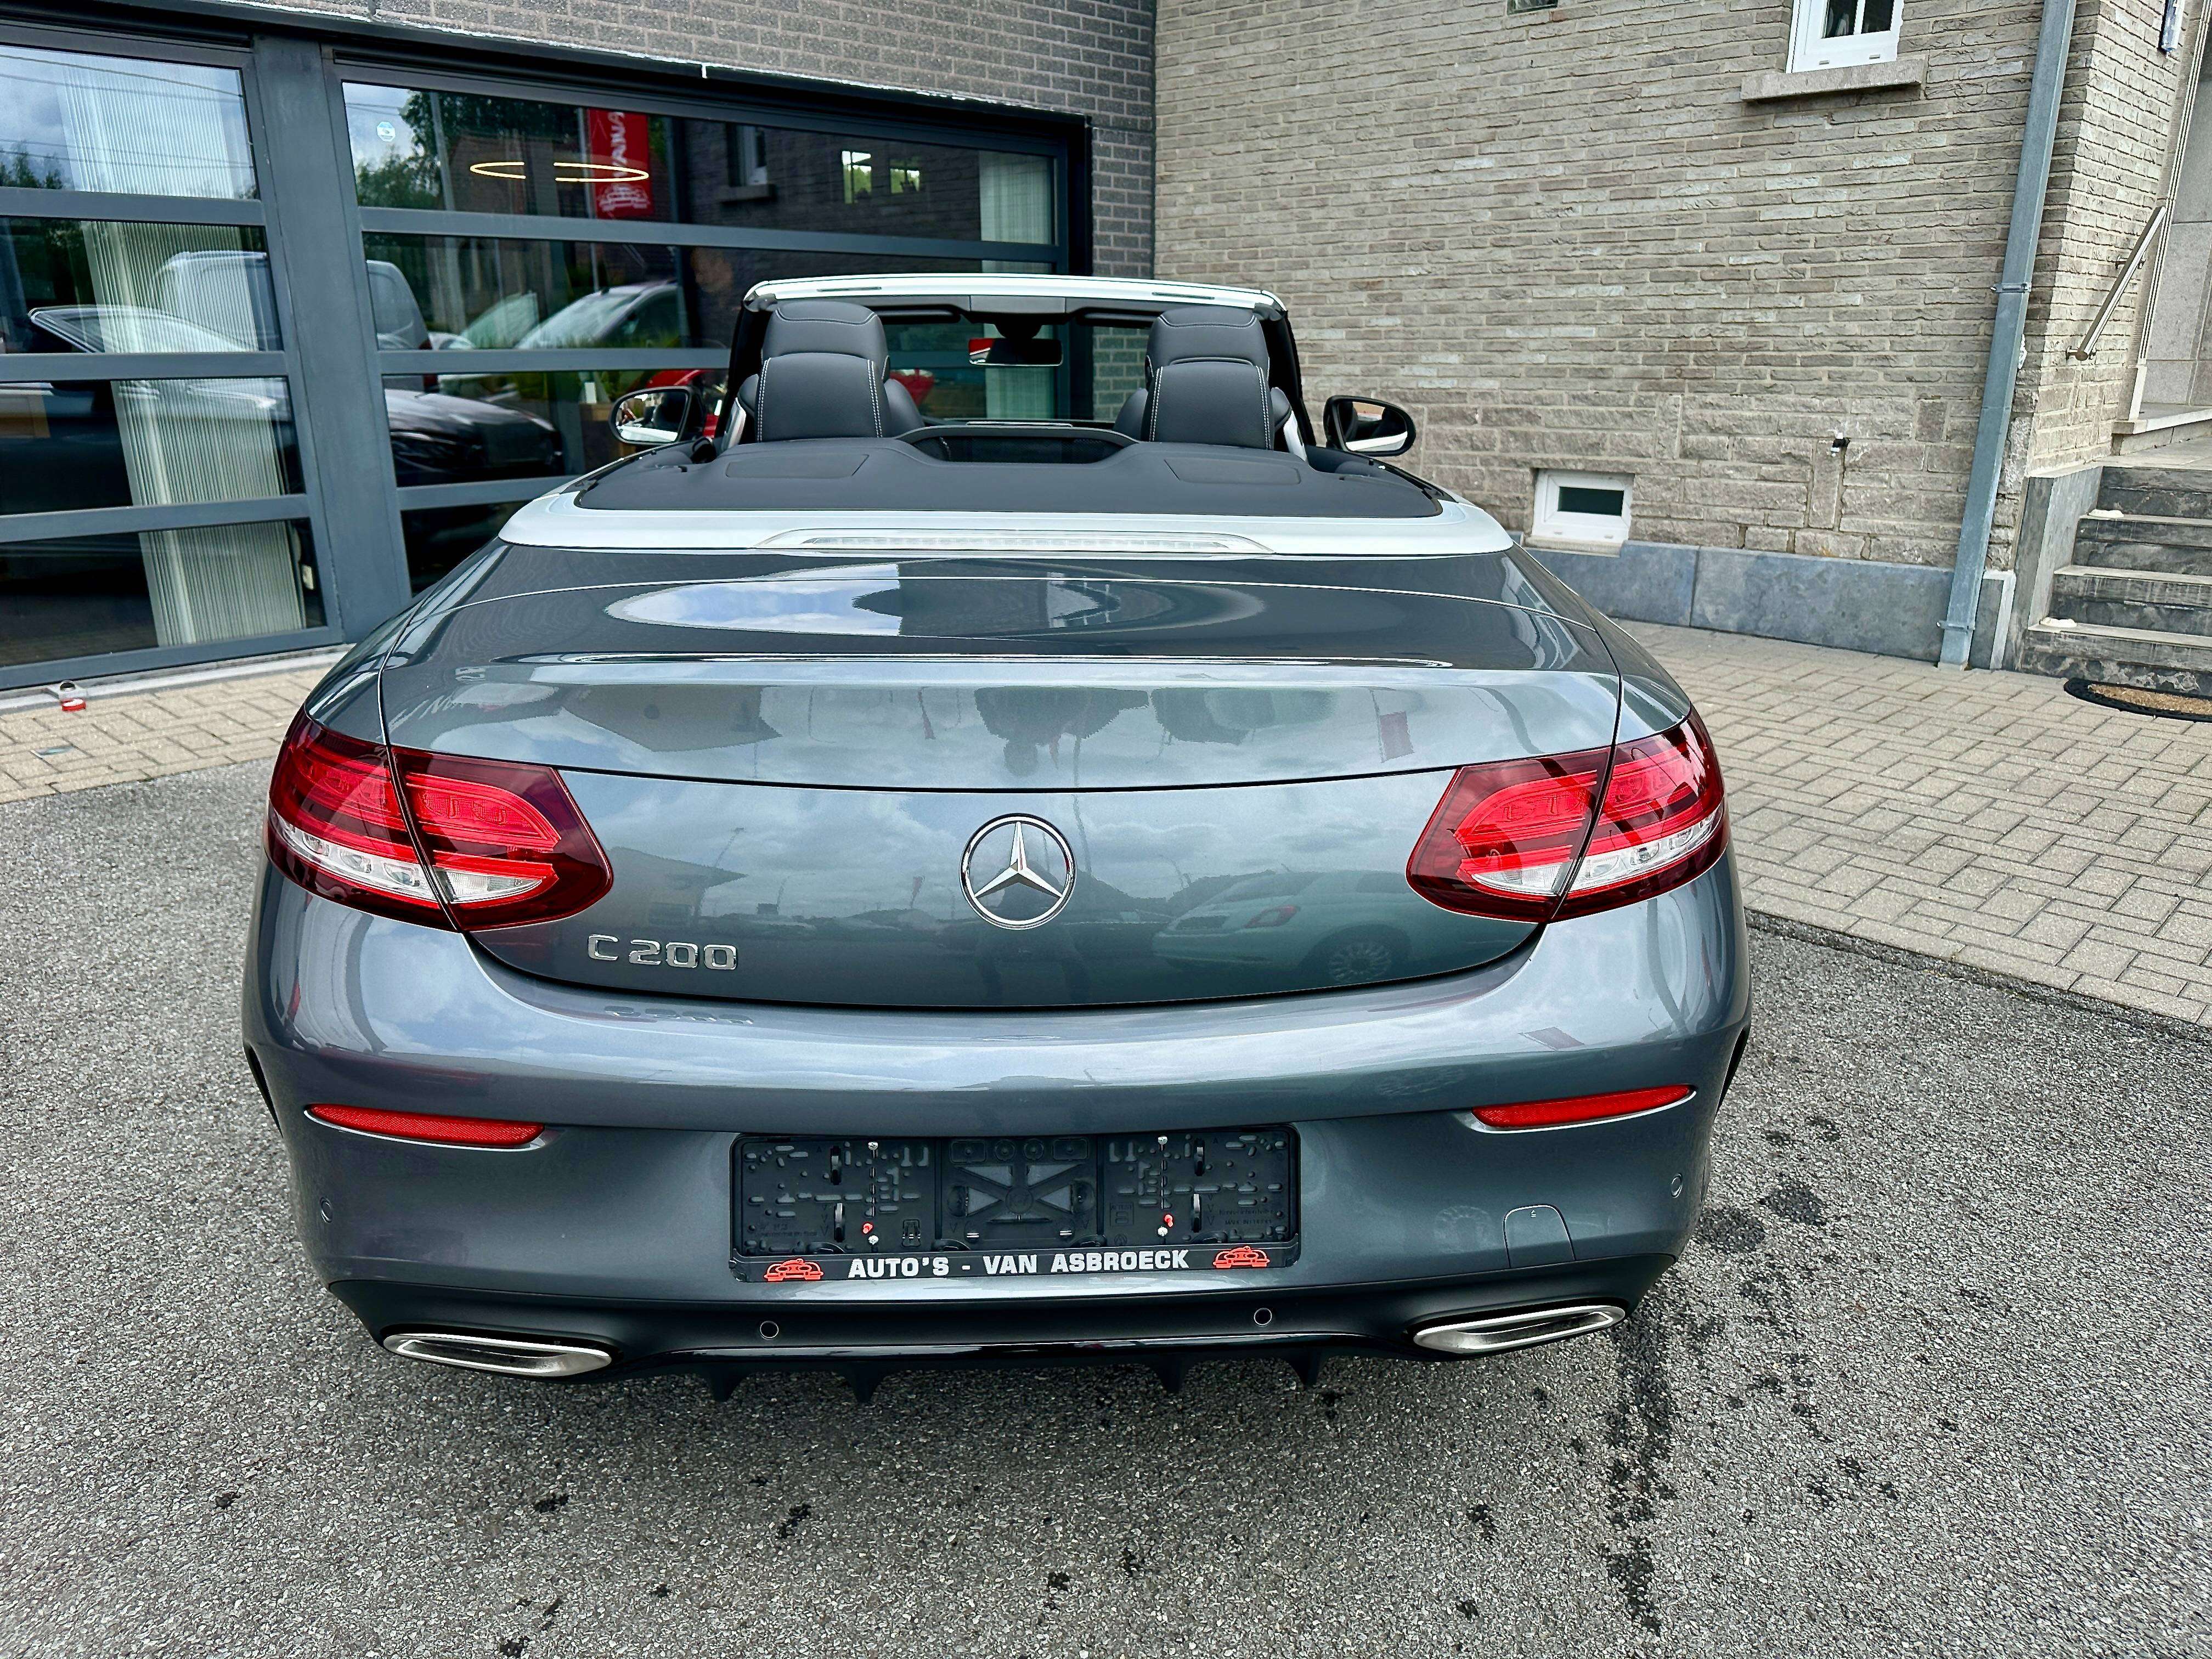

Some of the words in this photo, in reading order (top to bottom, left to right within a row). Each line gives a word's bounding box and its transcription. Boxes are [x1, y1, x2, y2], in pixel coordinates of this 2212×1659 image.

[588, 934, 618, 961] C
[629, 939, 737, 970] 200
[848, 1256, 949, 1278] AUTO'S
[983, 1255, 1037, 1274] VAN
[1051, 1249, 1189, 1273] ASBROECK
